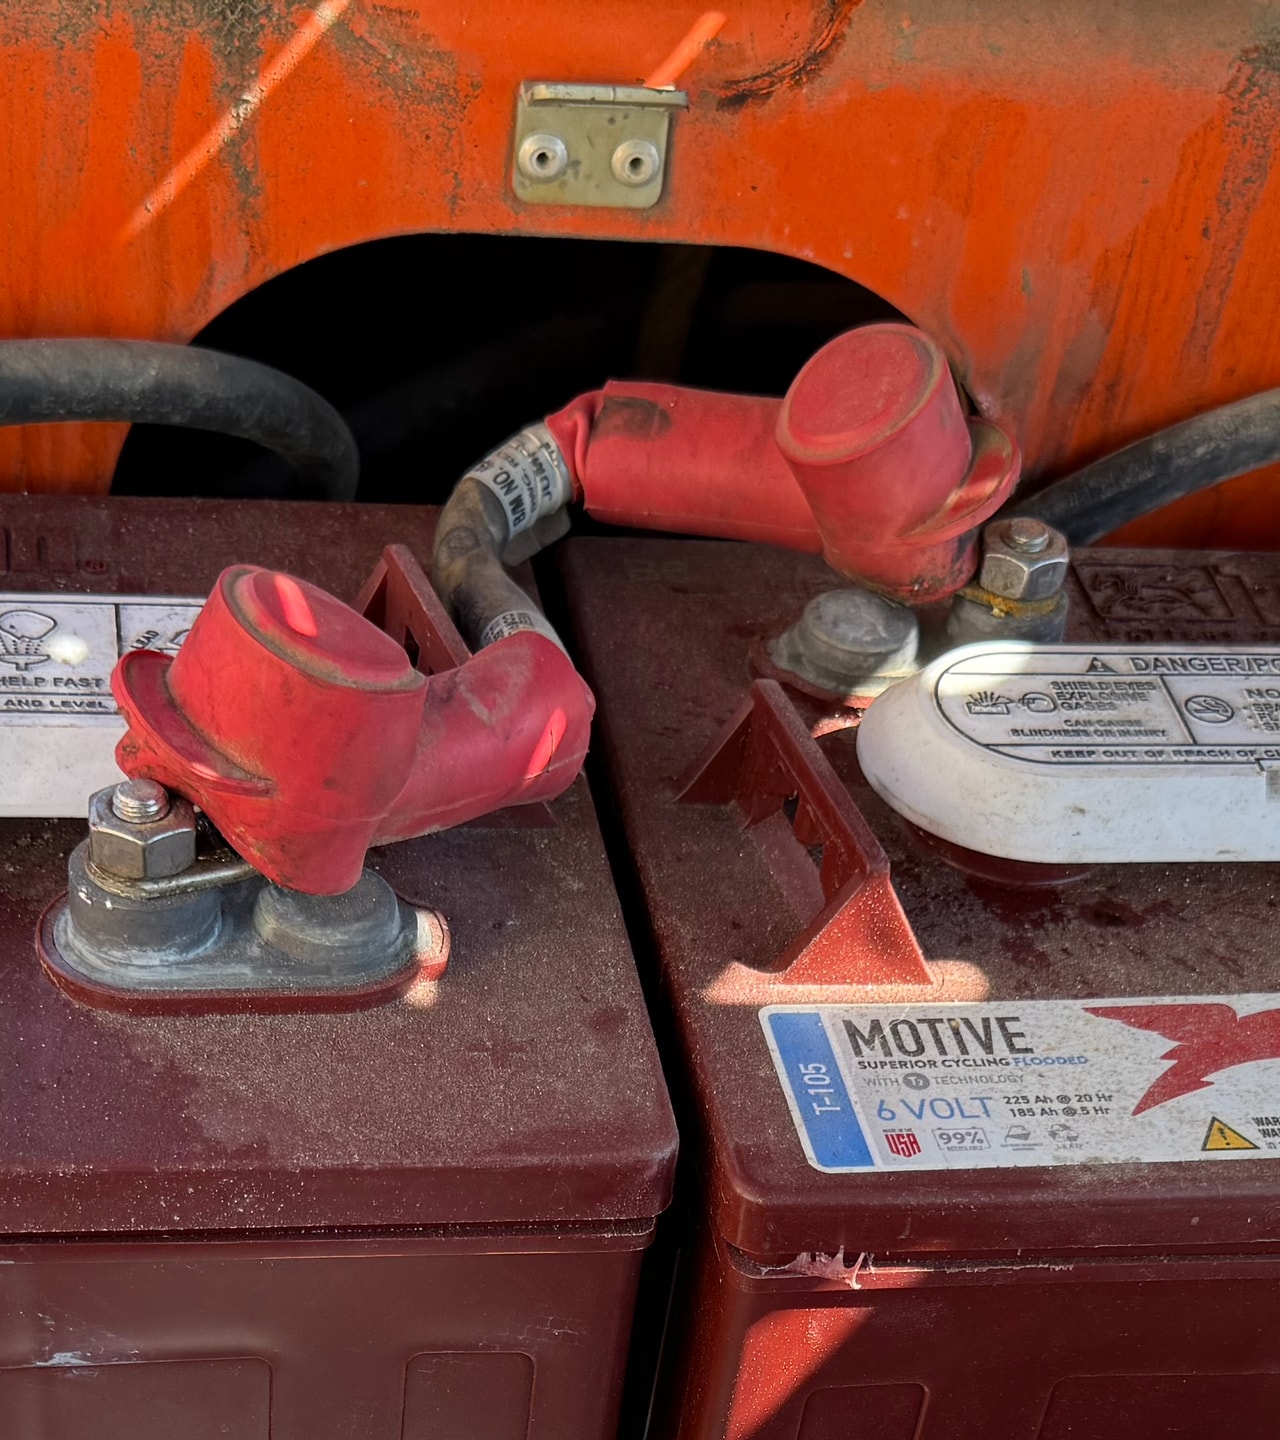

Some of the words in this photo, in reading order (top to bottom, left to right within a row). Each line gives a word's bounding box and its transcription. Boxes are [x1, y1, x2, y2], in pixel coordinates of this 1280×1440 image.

[130, 630, 160, 650] LEAD
[53, 677, 103, 689] FAST
[1050, 681, 1107, 691] SHIELD
[1113, 681, 1156, 691] EYES
[1056, 691, 1148, 701] EXPLOSIVE
[3, 699, 42, 709] AND
[49, 700, 108, 710] LEVEL
[1061, 701, 1117, 711] GASES
[1051, 750, 1098, 758] KEEP
[1102, 750, 1137, 758] OUT
[1143, 750, 1164, 758] OF
[1173, 750, 1234, 758] REACH
[1237, 750, 1255, 758] OF
[842, 1017, 1034, 1057] MOTIVE
[858, 1059, 938, 1070] SUPERIOR
[942, 1057, 1010, 1068] CYCLING
[1013, 1055, 1088, 1067] FLOODED
[864, 1077, 899, 1087] WITH
[933, 1074, 1025, 1086] TECHNOLOGY
[798, 1063, 841, 1116] T-105
[1003, 1095, 1031, 1105] 225
[1034, 1094, 1053, 1104] Ah
[1056, 1094, 1071, 1104] @
[1074, 1094, 1093, 1103] 20
[1095, 1093, 1113, 1103] Hr
[876, 1099, 896, 1121] 6
[900, 1096, 992, 1121] VOLT
[1009, 1107, 1036, 1118] 185
[1040, 1107, 1058, 1117] Ah
[1062, 1107, 1077, 1117] @
[1080, 1106, 1090, 1116] 5
[1093, 1106, 1111, 1115] Hr
[938, 1132, 984, 1145] 99%
[884, 1133, 922, 1158] USA
